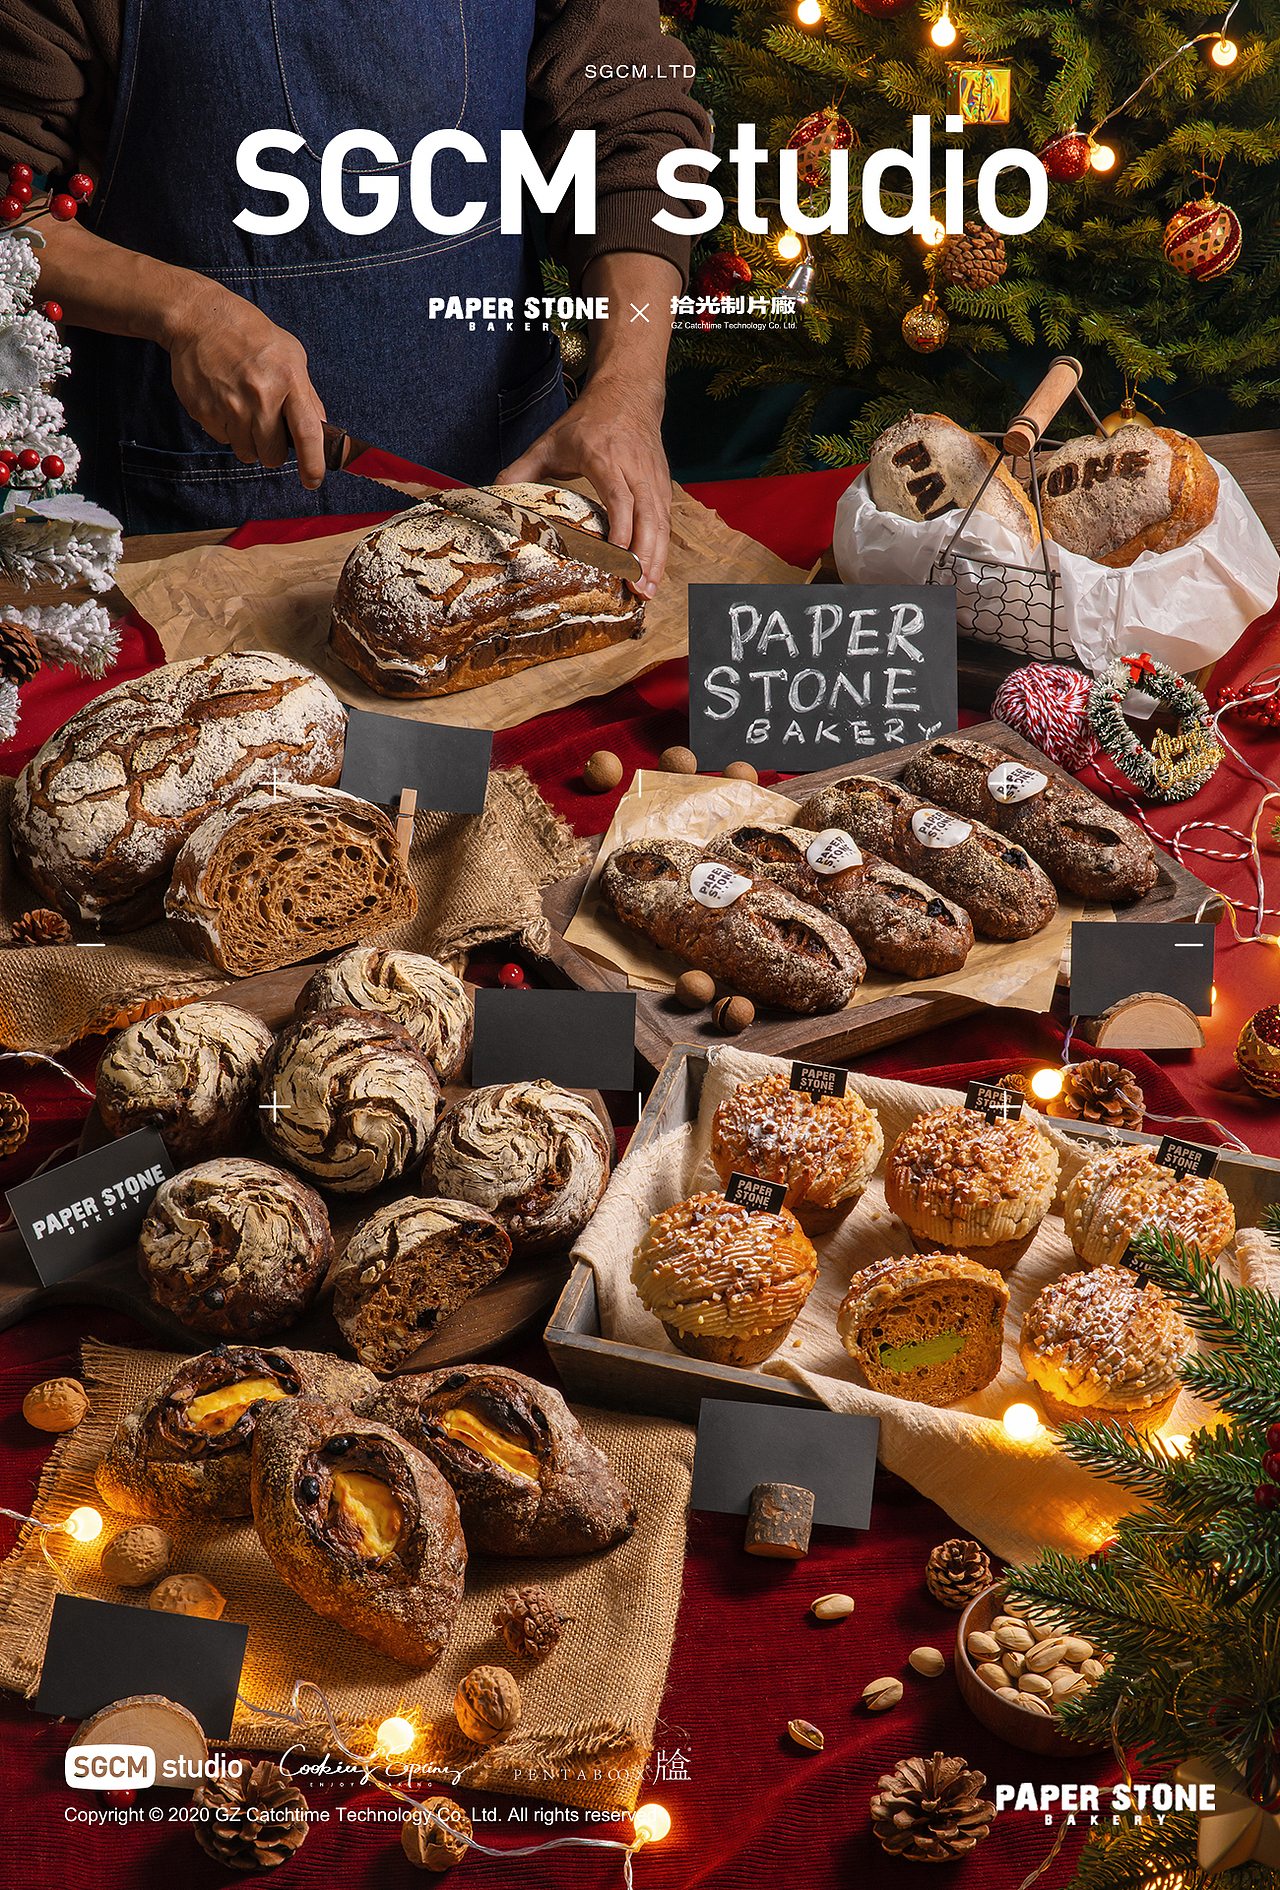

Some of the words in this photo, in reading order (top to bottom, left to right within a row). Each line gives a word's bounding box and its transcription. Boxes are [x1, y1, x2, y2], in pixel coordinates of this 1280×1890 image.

[728, 601, 925, 663] PAPER
[703, 665, 921, 721] STONE
[745, 718, 942, 745] BAKERY
[800, 1077, 835, 1091] STONE
[801, 1068, 836, 1082] PAPER
[977, 1088, 1013, 1104] PAPER
[1167, 1143, 1203, 1162] PAPER
[1164, 1153, 1200, 1171] STONE
[737, 1180, 773, 1197] PAPER
[32, 1196, 99, 1241] PAPER
[101, 1163, 166, 1208] STONE
[734, 1189, 771, 1207] STONE
[68, 1195, 140, 1235] BAKERY
